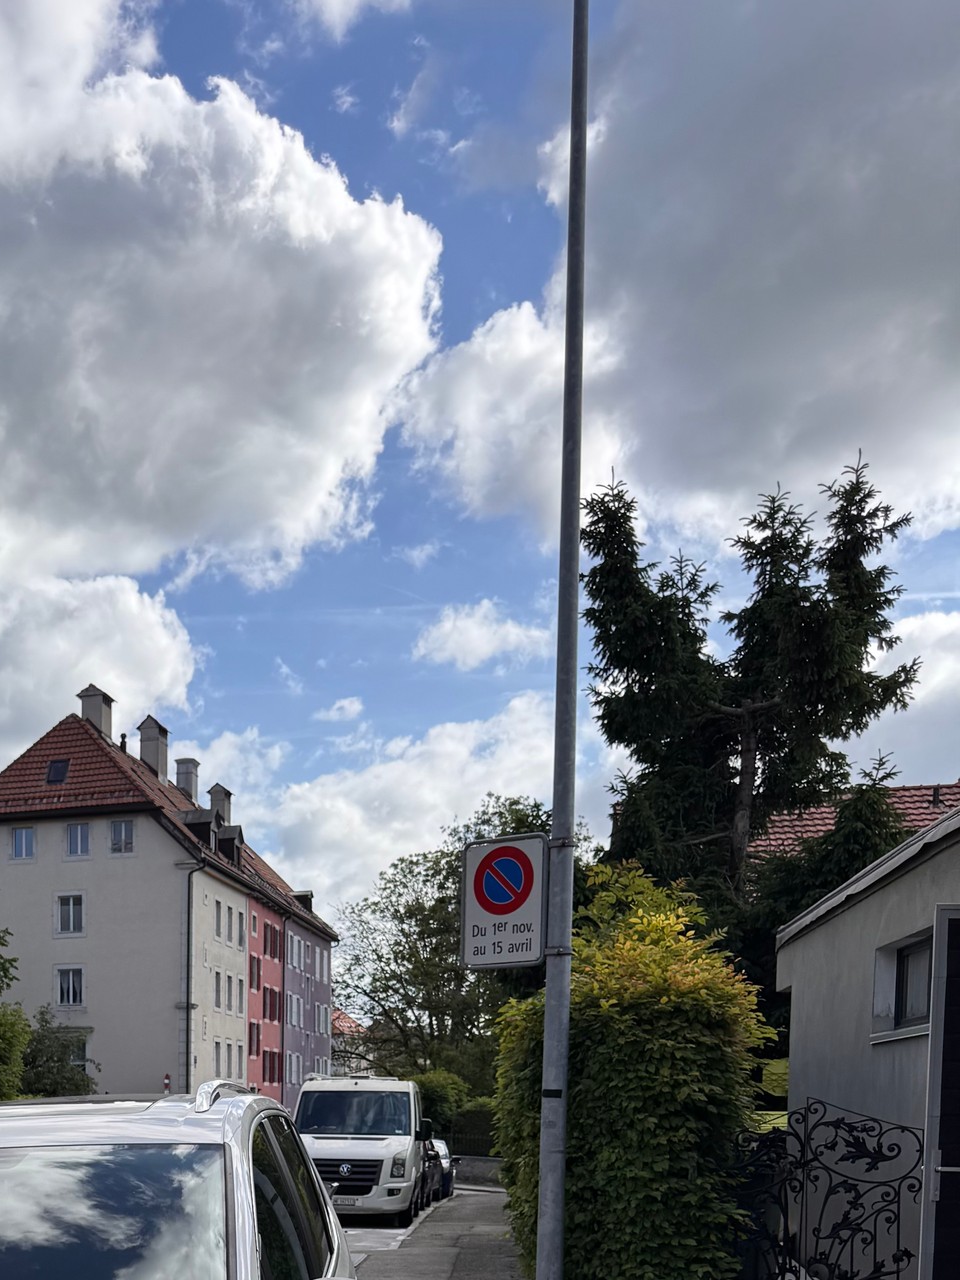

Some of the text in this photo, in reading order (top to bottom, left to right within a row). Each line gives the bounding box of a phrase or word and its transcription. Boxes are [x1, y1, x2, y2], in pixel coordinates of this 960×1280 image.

[472, 921, 534, 938] Du 1er nov.
[472, 938, 532, 956] au 15 avril
